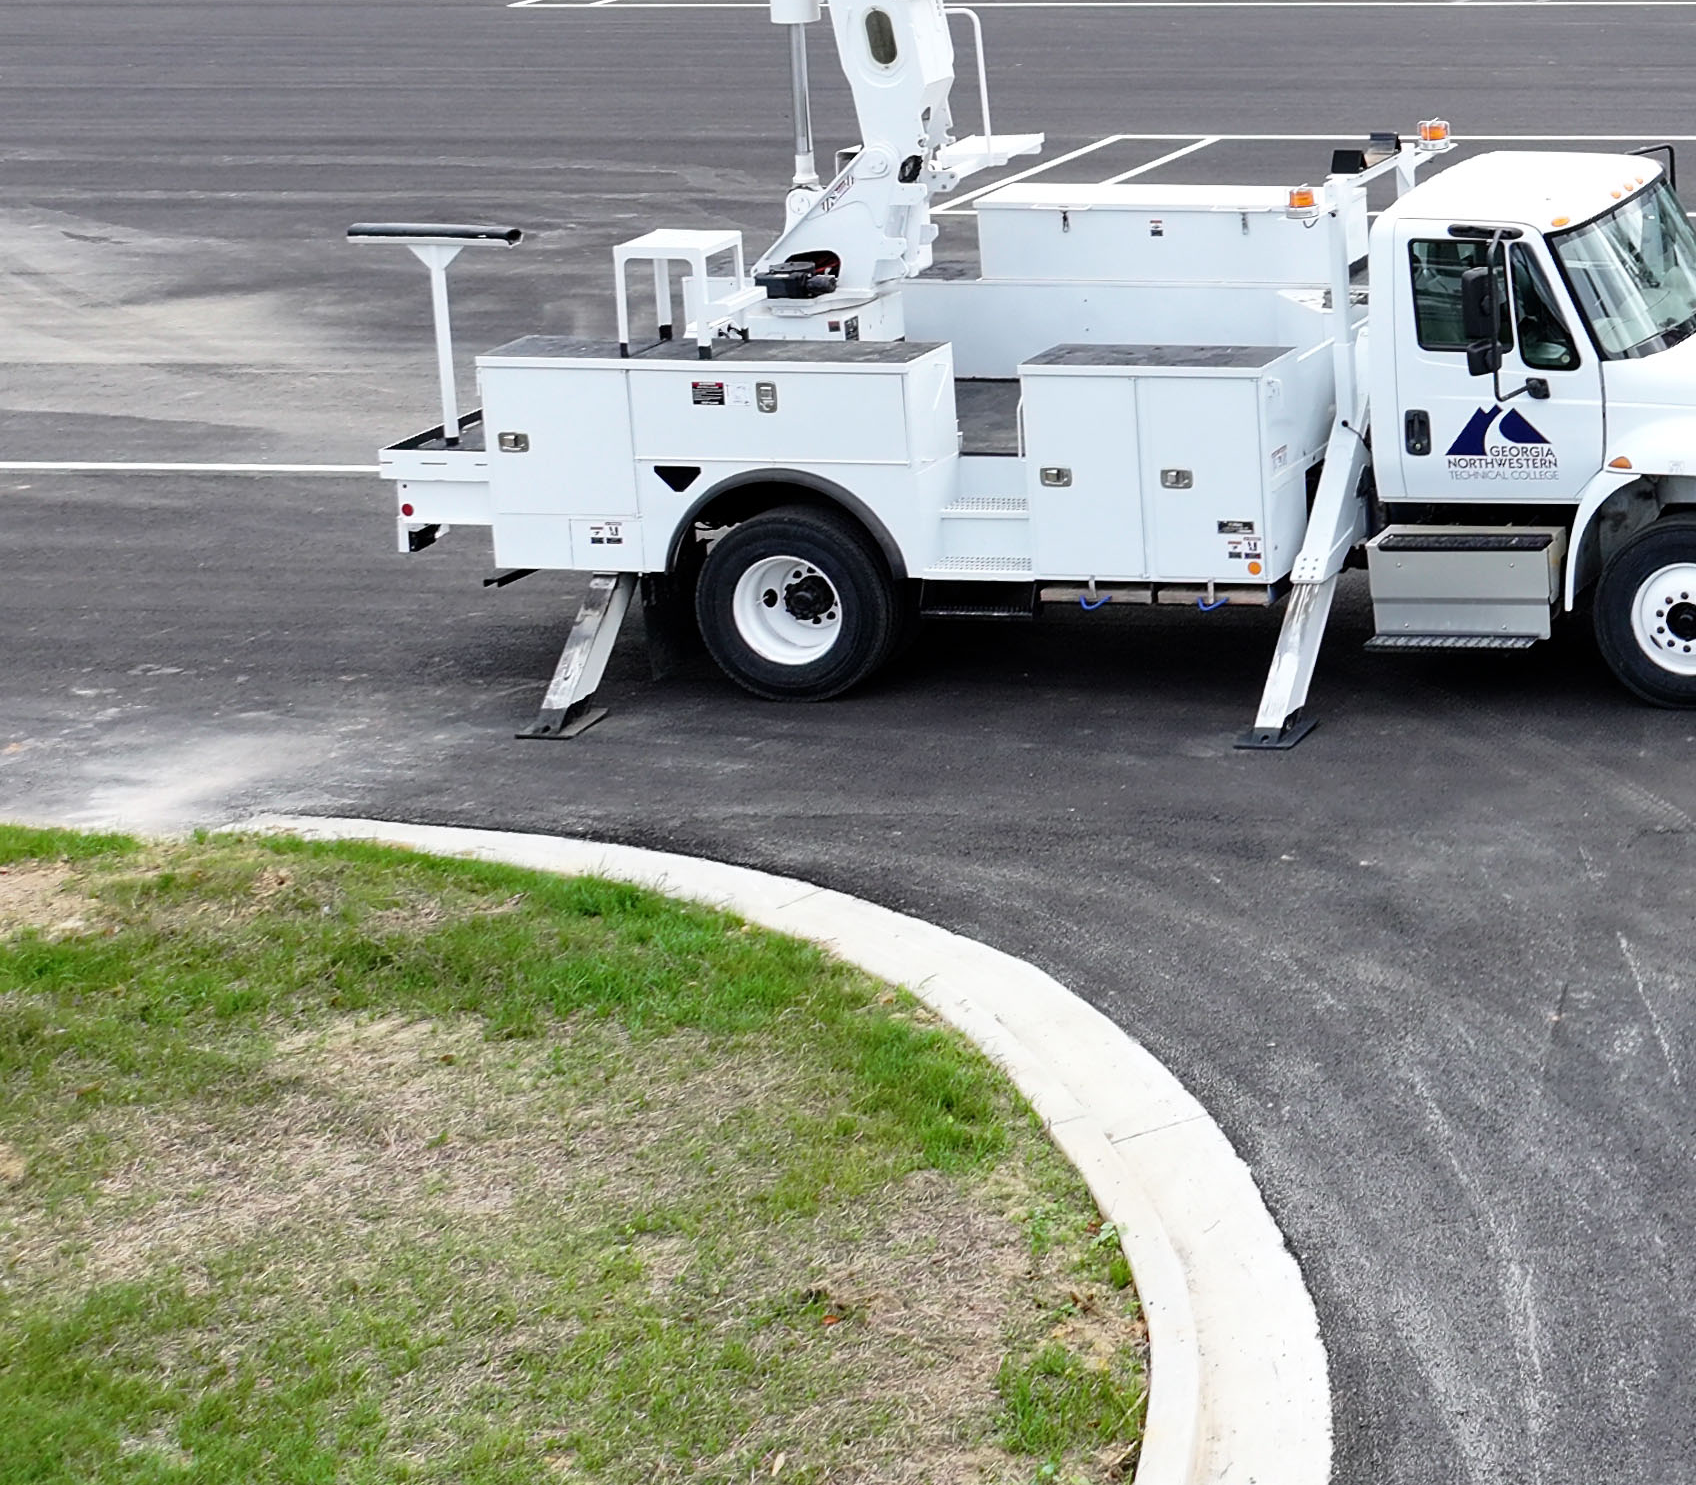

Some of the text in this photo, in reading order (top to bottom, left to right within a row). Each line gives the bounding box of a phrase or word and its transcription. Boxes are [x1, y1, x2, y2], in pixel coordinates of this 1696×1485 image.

[1490, 446, 1556, 457] GEORGIA
[1448, 458, 1557, 469] NORTHWESTERN
[1449, 470, 1559, 480] TECHNICAL COLLEGE
